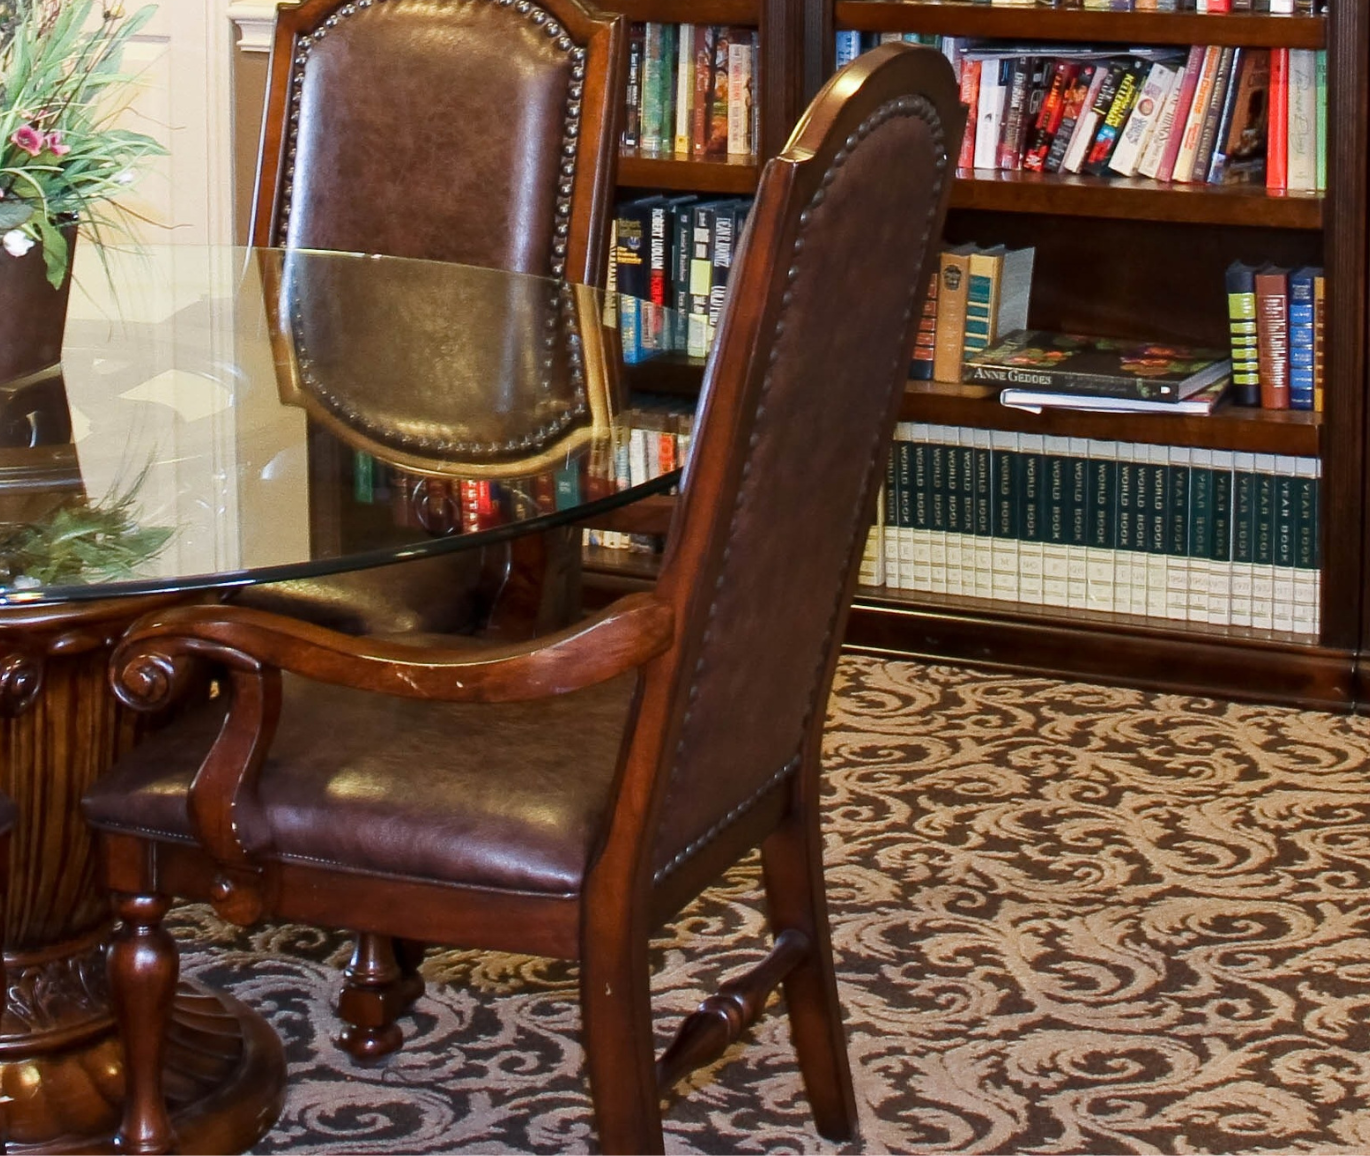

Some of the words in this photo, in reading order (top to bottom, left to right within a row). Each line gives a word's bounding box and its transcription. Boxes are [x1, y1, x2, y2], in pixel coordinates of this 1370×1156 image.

[651, 208, 664, 237] ROBERT
[651, 239, 664, 269] LUDLUM
[974, 367, 1006, 381] ANNE
[1008, 369, 1053, 385] GEDDES
[948, 450, 956, 489] WORLD
[1052, 460, 1060, 500] WORLD
[1155, 470, 1163, 510] WORLD
[1281, 481, 1289, 517] YEAR
[1301, 484, 1309, 519] YEAR
[901, 491, 909, 524] BOOK
[949, 496, 957, 528] BOOK
[1154, 516, 1163, 550] BOOK
[1301, 527, 1309, 564] BOOK
